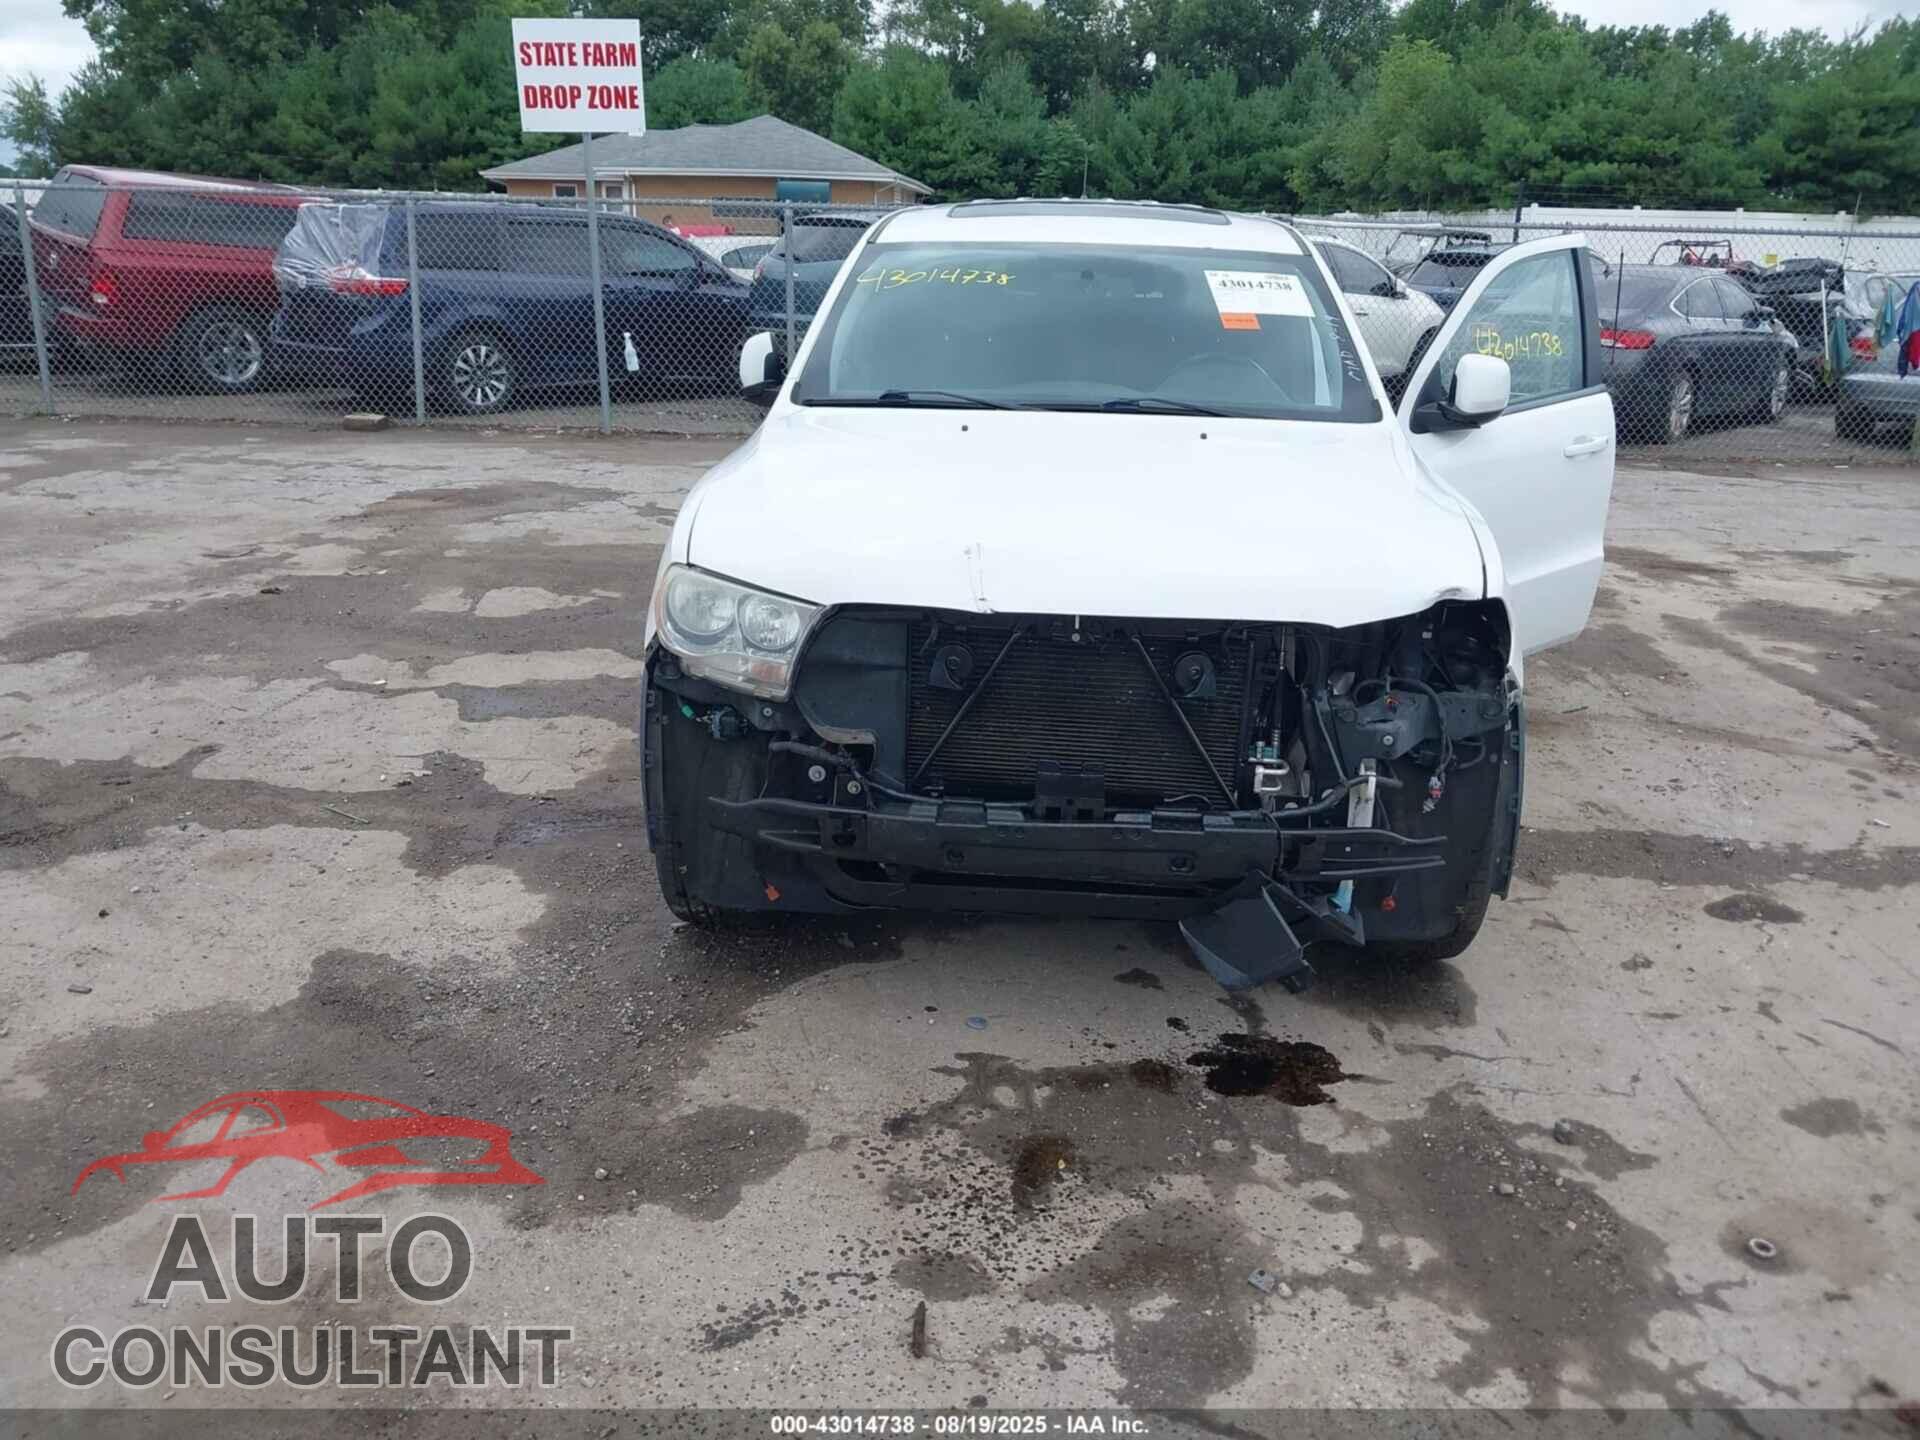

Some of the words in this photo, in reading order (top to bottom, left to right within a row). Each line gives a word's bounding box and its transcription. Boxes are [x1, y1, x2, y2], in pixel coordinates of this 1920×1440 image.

[519, 42, 578, 66] STATE
[582, 42, 637, 67] FARM
[523, 85, 582, 109] DROP
[587, 85, 640, 109] ZONE
[857, 268, 1016, 292] 43014738
[1218, 279, 1293, 291] 43014738
